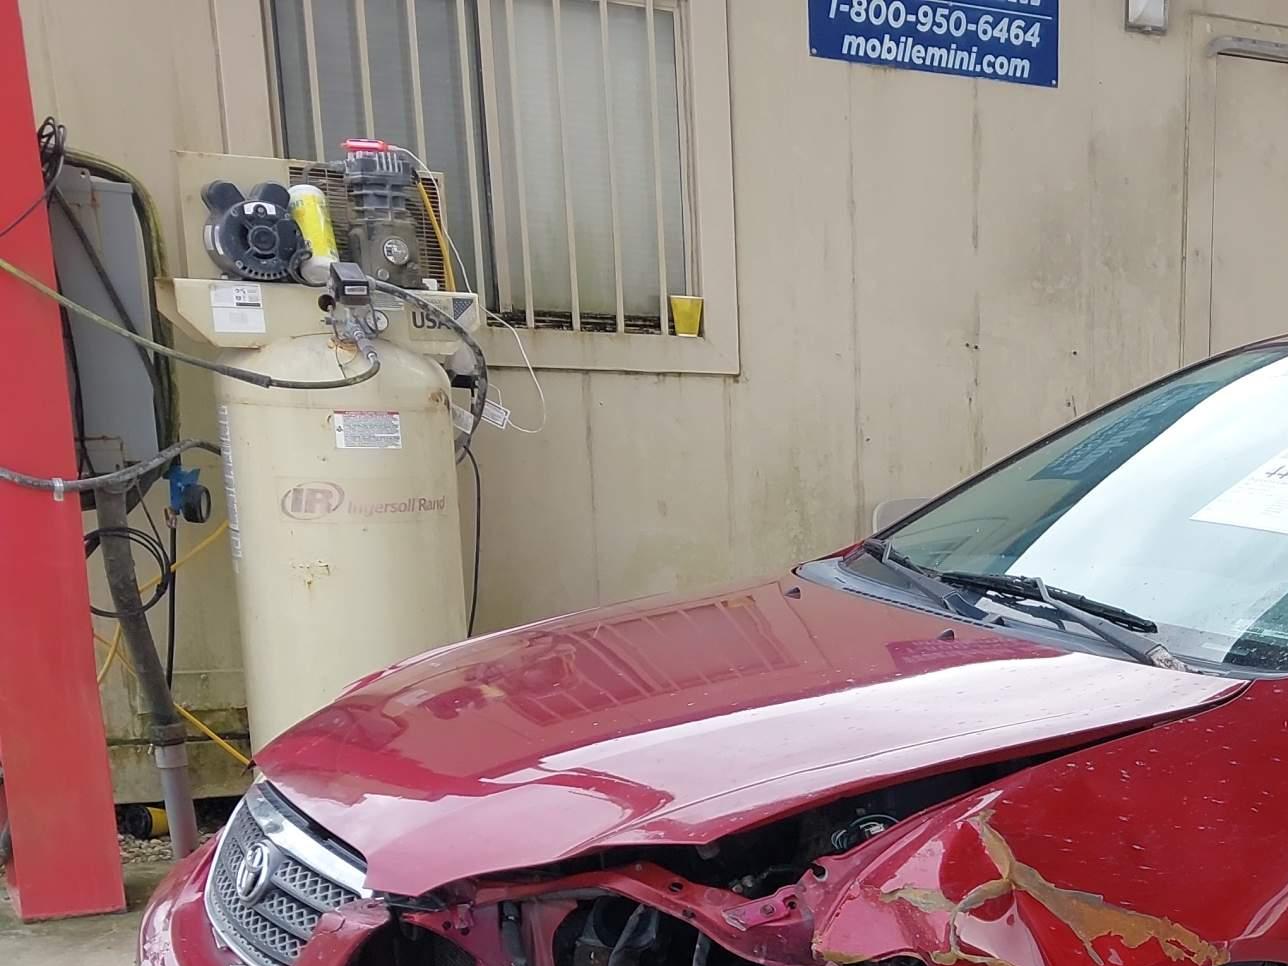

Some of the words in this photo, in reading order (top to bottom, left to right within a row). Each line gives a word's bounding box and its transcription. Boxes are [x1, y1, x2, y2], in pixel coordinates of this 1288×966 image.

[828, 0, 1040, 48] 1-800-950-6464
[841, 34, 1031, 78] mobilemini.com
[348, 498, 415, 518] Ingersoll
[417, 496, 446, 512] Rand
